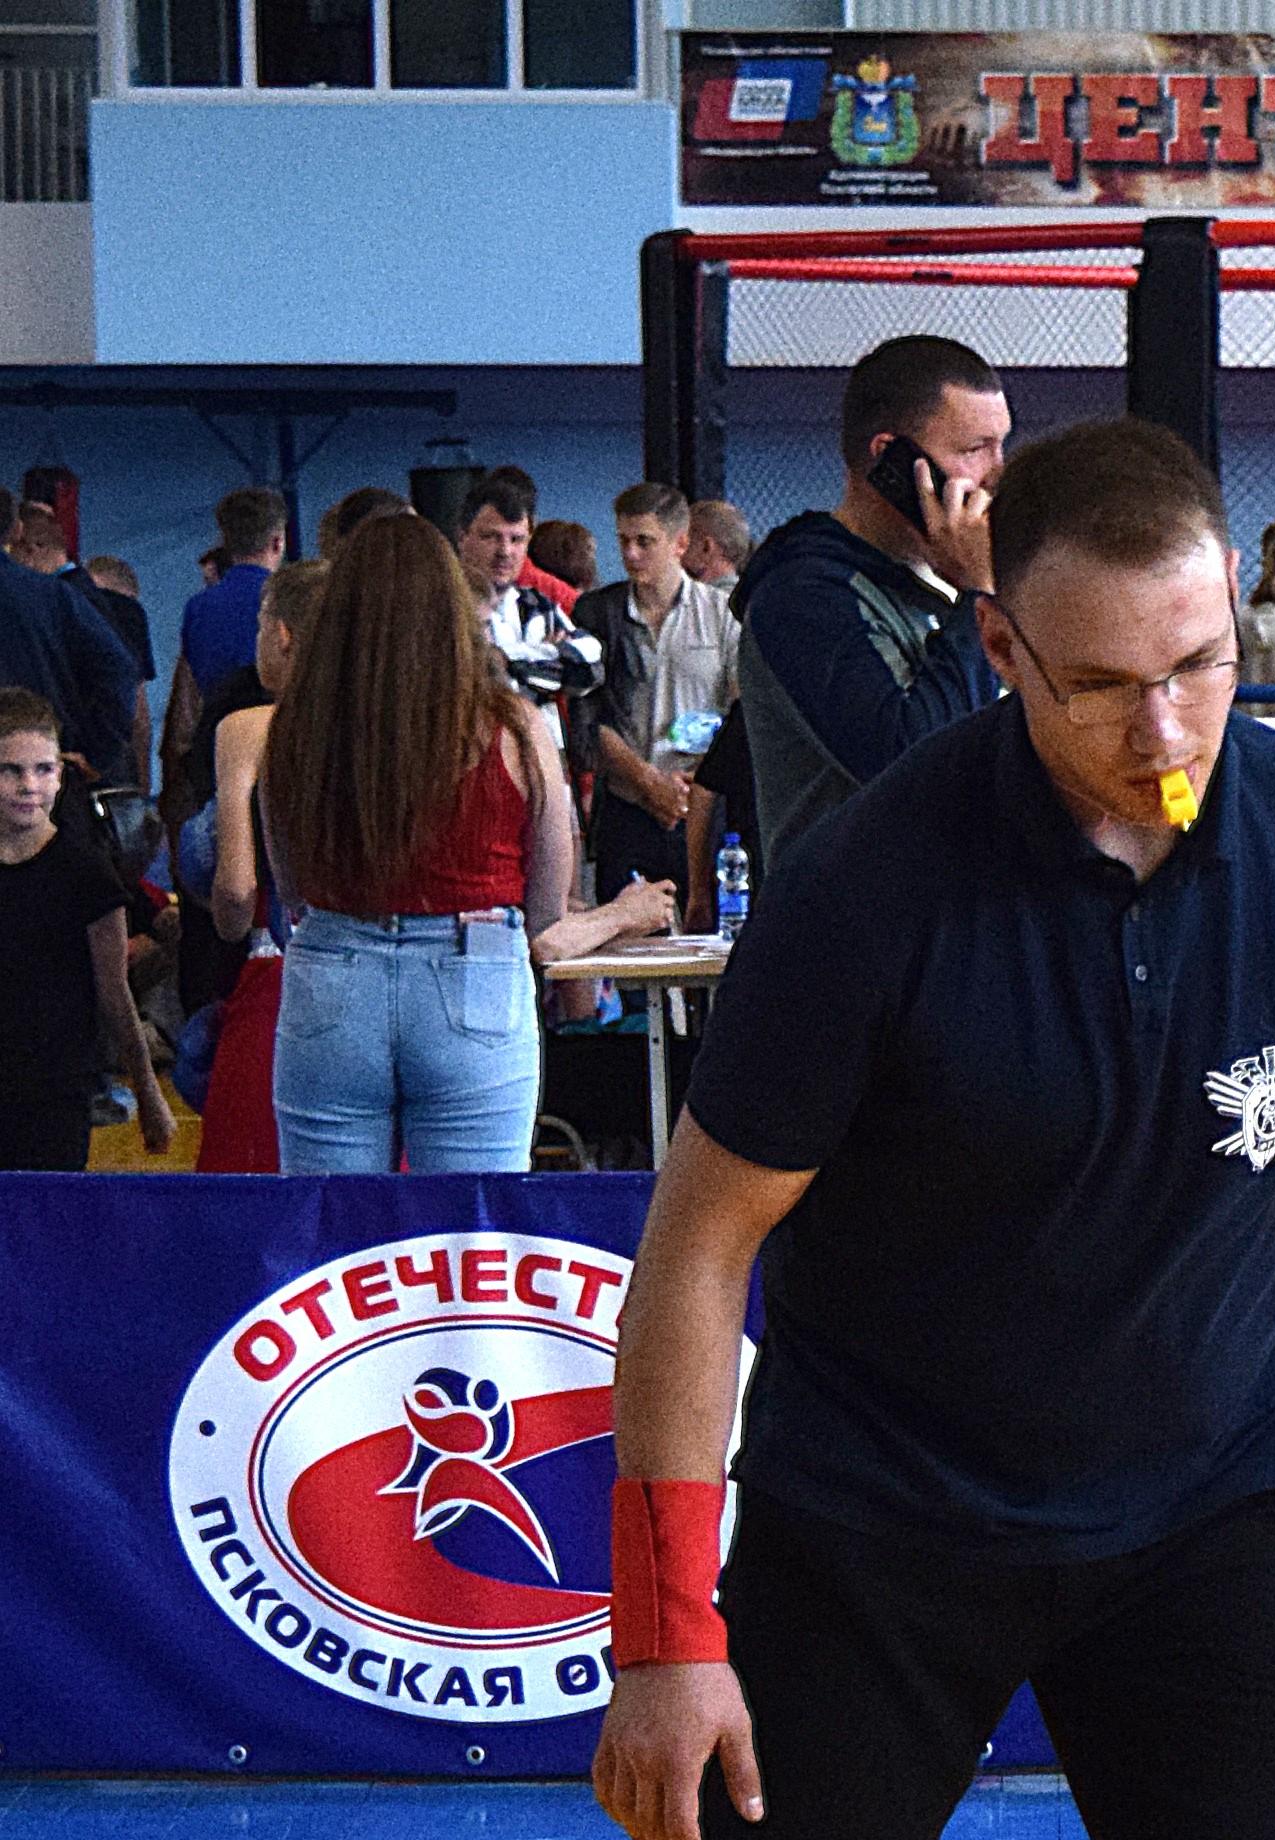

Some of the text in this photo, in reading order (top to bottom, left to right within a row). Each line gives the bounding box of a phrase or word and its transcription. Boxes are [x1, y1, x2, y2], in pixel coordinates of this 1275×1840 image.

[234, 1249, 622, 1383] ОТЕЧЕСТ
[190, 1496, 616, 1707] ПСКОВСКАЯ О
